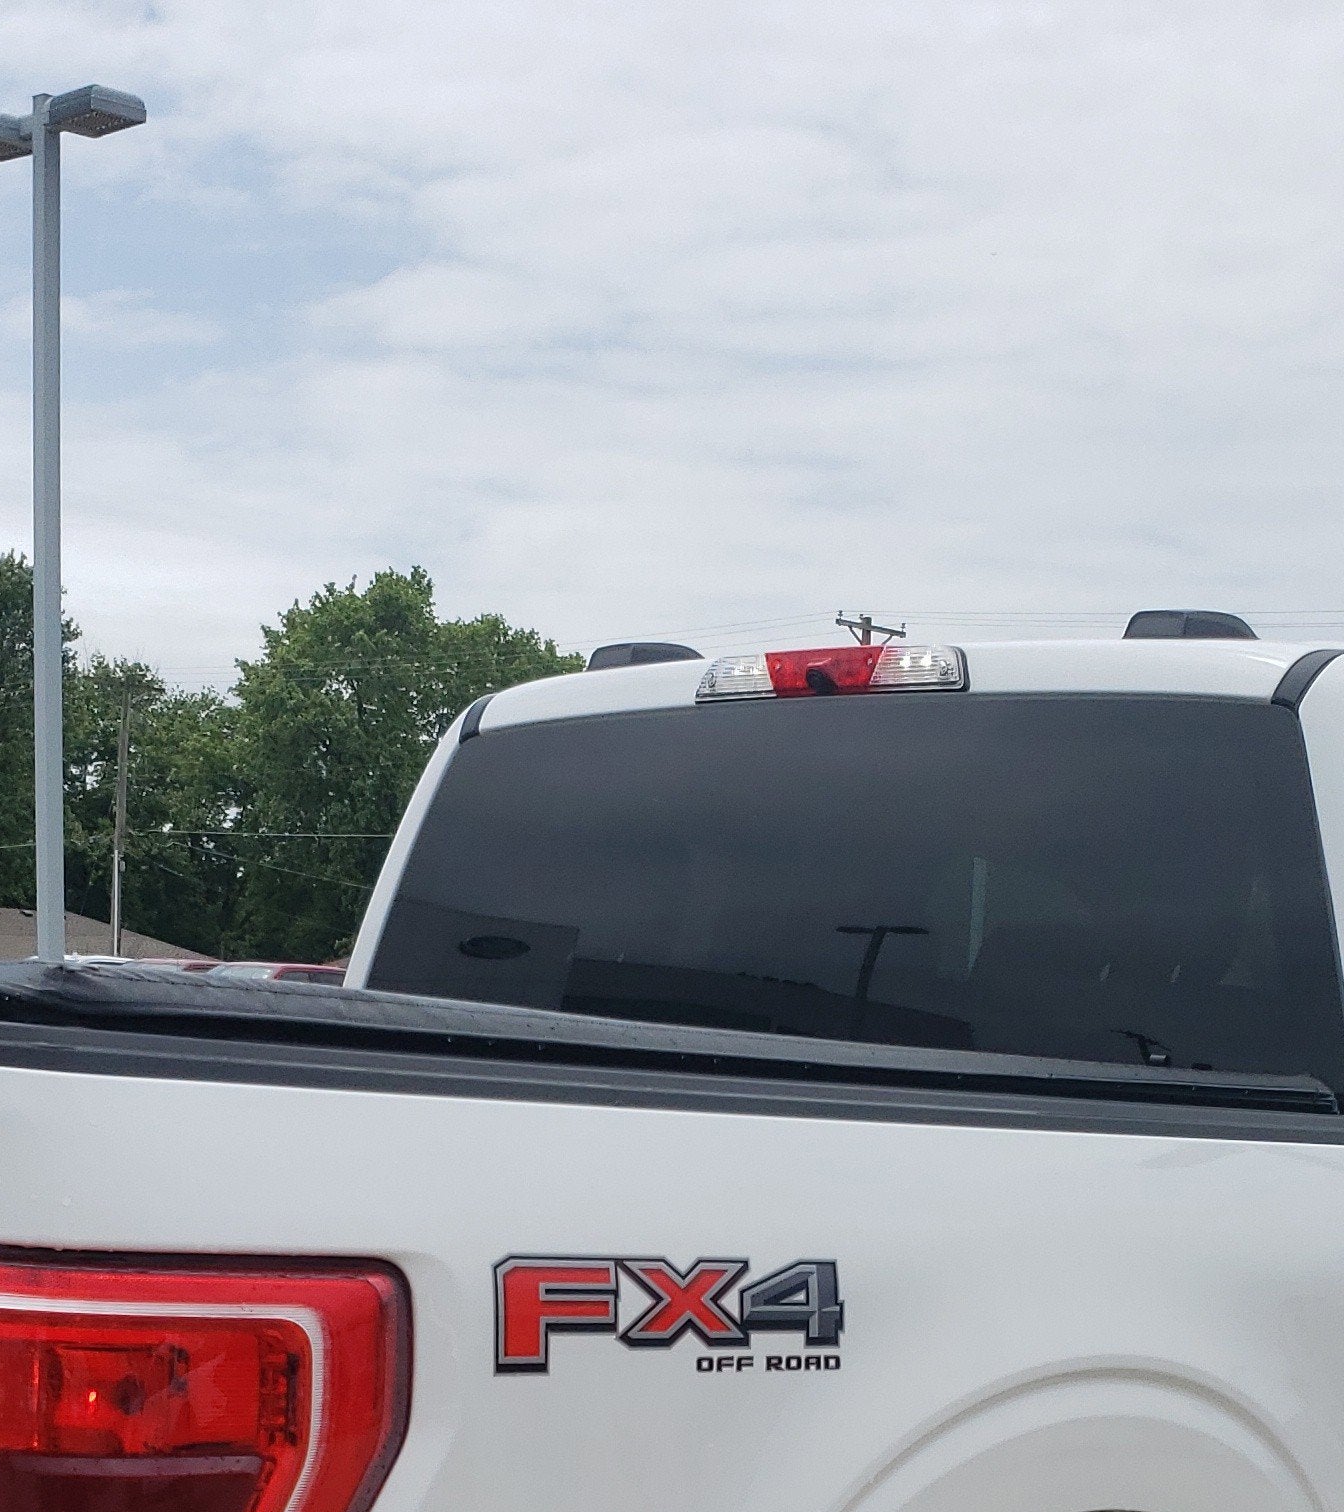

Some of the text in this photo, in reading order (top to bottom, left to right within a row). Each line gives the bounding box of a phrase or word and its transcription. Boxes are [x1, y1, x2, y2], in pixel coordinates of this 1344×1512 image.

[493, 1254, 844, 1376] FX4
[696, 1354, 841, 1373] OFF ROAD
